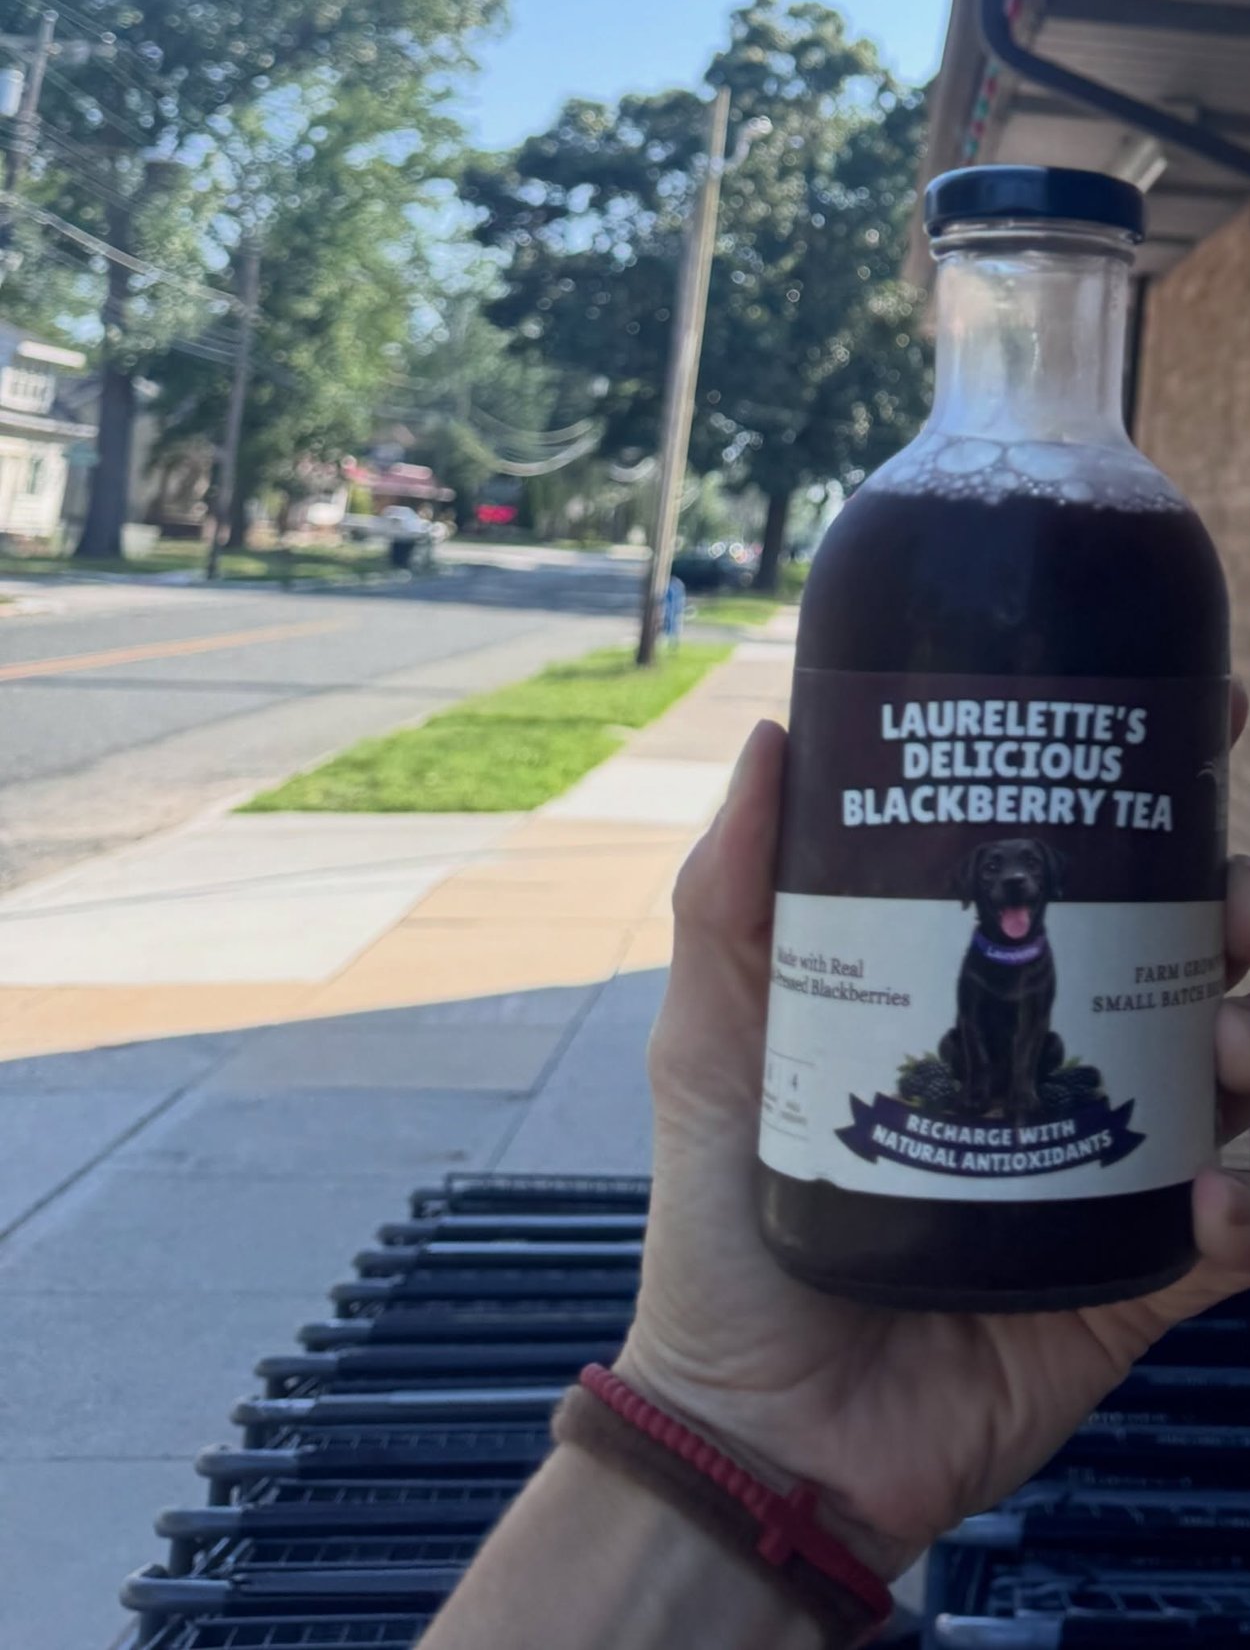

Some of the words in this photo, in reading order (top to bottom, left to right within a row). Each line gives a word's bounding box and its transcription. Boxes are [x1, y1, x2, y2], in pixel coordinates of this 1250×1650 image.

[881, 700, 1148, 744] LAURELETTE'S
[902, 741, 1124, 782] DELICIOUS
[842, 784, 1107, 827] BLACKBERRY
[1112, 790, 1173, 832] TEA
[800, 952, 827, 974] with
[830, 957, 864, 978] Real
[1134, 962, 1180, 984] FARM
[810, 978, 911, 1007] Blackberries
[1091, 991, 1157, 1013] SMALL
[905, 1113, 1013, 1147] RECHARGE
[1017, 1118, 1076, 1145] WITH
[871, 1123, 958, 1169] NATURAL
[960, 1129, 1113, 1172] ANTIOXIDANTS
